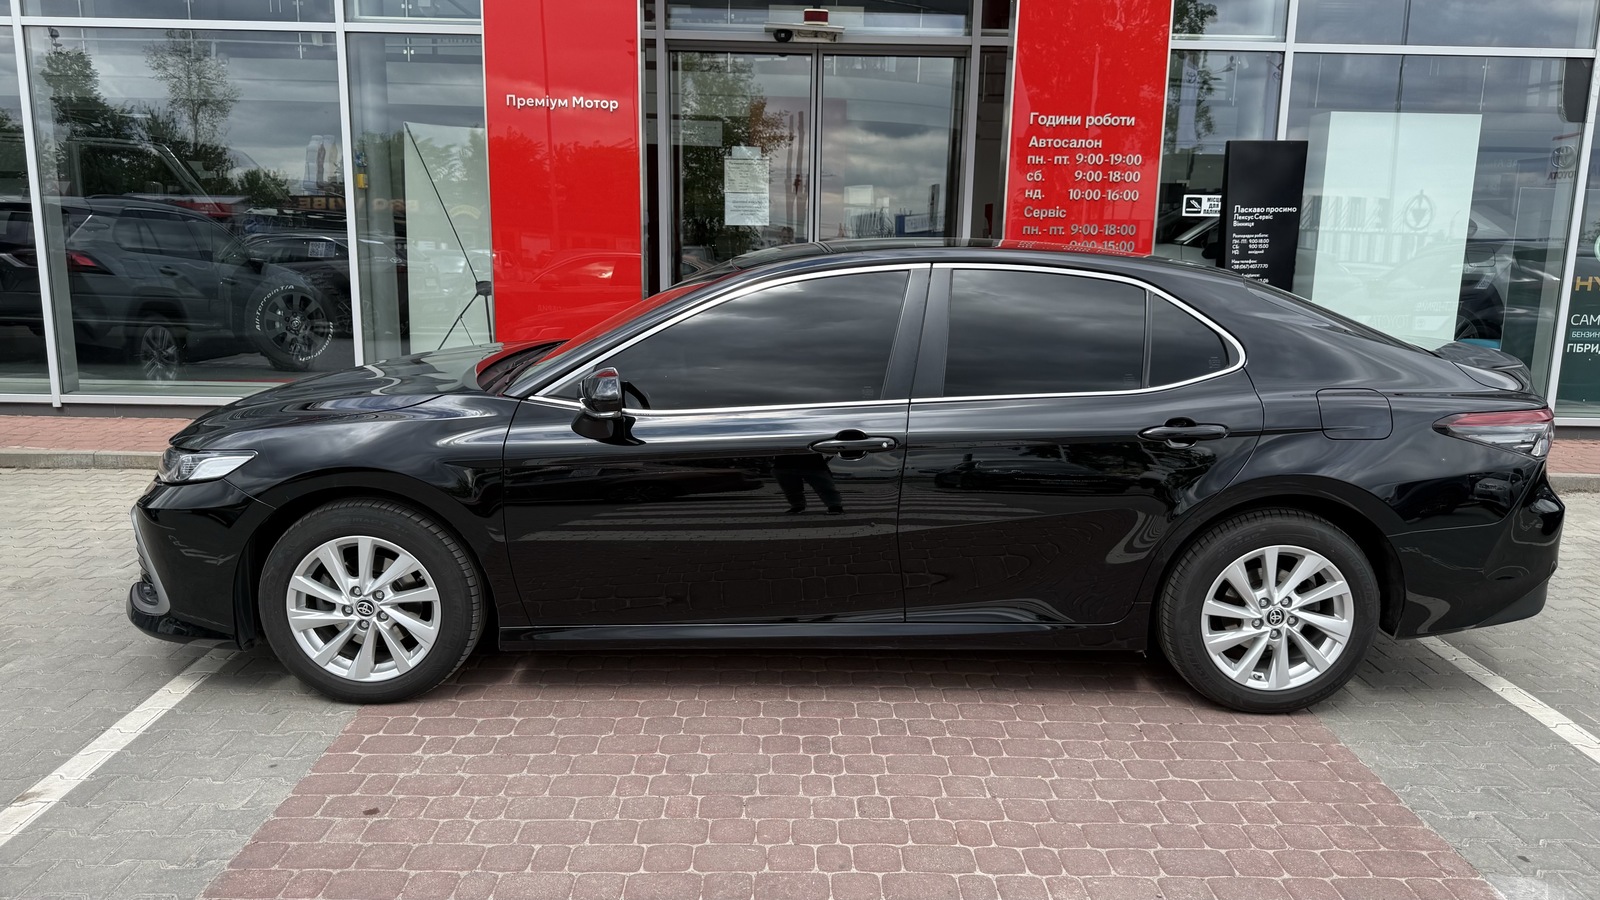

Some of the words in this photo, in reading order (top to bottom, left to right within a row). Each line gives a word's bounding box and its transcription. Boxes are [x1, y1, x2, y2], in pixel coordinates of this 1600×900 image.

[506, 94, 568, 110] Преміум
[572, 96, 619, 112] Мотор
[1029, 112, 1081, 127] Години
[1085, 113, 1135, 128] роботи
[1028, 135, 1102, 148] Автосалон
[1075, 153, 1142, 165] 9:00-19:00
[1026, 170, 1045, 181] сб.
[1074, 170, 1141, 182] 9:00-18:00
[1025, 189, 1045, 200] нд.
[1068, 188, 1140, 201] 10:00-16:00
[1023, 206, 1067, 220] Сервіс
[1233, 205, 1265, 213] Ласкаво
[1266, 206, 1297, 214] просимо
[1070, 224, 1136, 236] 9:00-18:00
[1566, 343, 1600, 354] ГІБРИ
